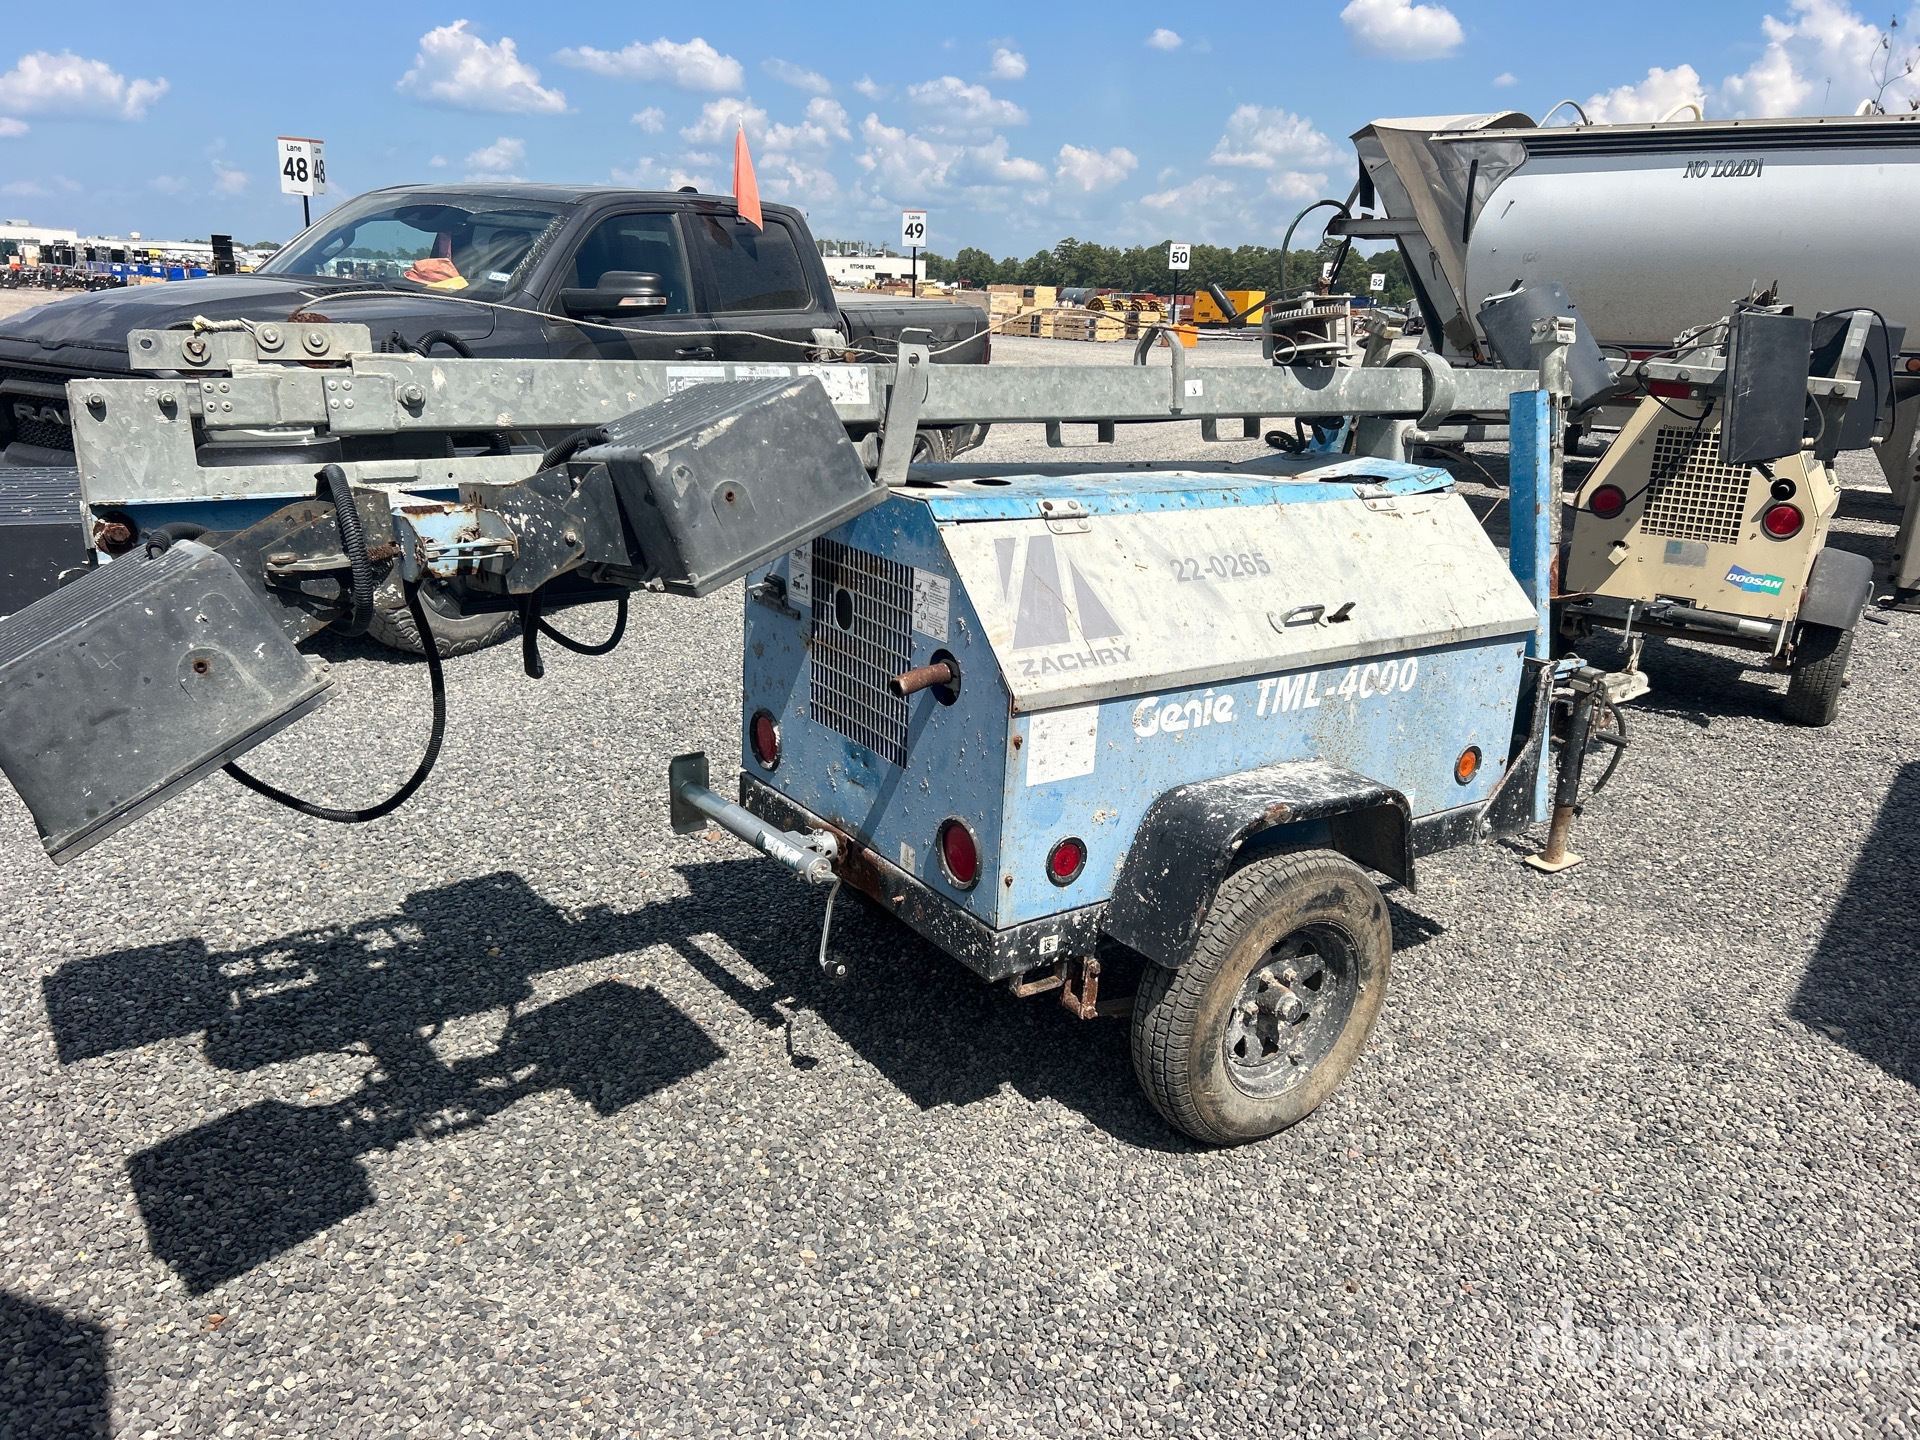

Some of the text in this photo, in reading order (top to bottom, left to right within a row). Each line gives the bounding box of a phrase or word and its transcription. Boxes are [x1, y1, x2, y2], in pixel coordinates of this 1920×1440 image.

[286, 143, 302, 153] Lane
[283, 156, 309, 183] 48
[313, 159, 326, 184] 48
[1683, 160, 1710, 178] NO
[904, 222, 924, 239] 49
[1171, 251, 1188, 264] 50
[1372, 278, 1383, 287] 52
[1169, 552, 1271, 583] 22-0265
[1725, 572, 1783, 589] DOOSAN
[1017, 645, 1132, 677] ZACHRY
[1132, 688, 1234, 738] Genie
